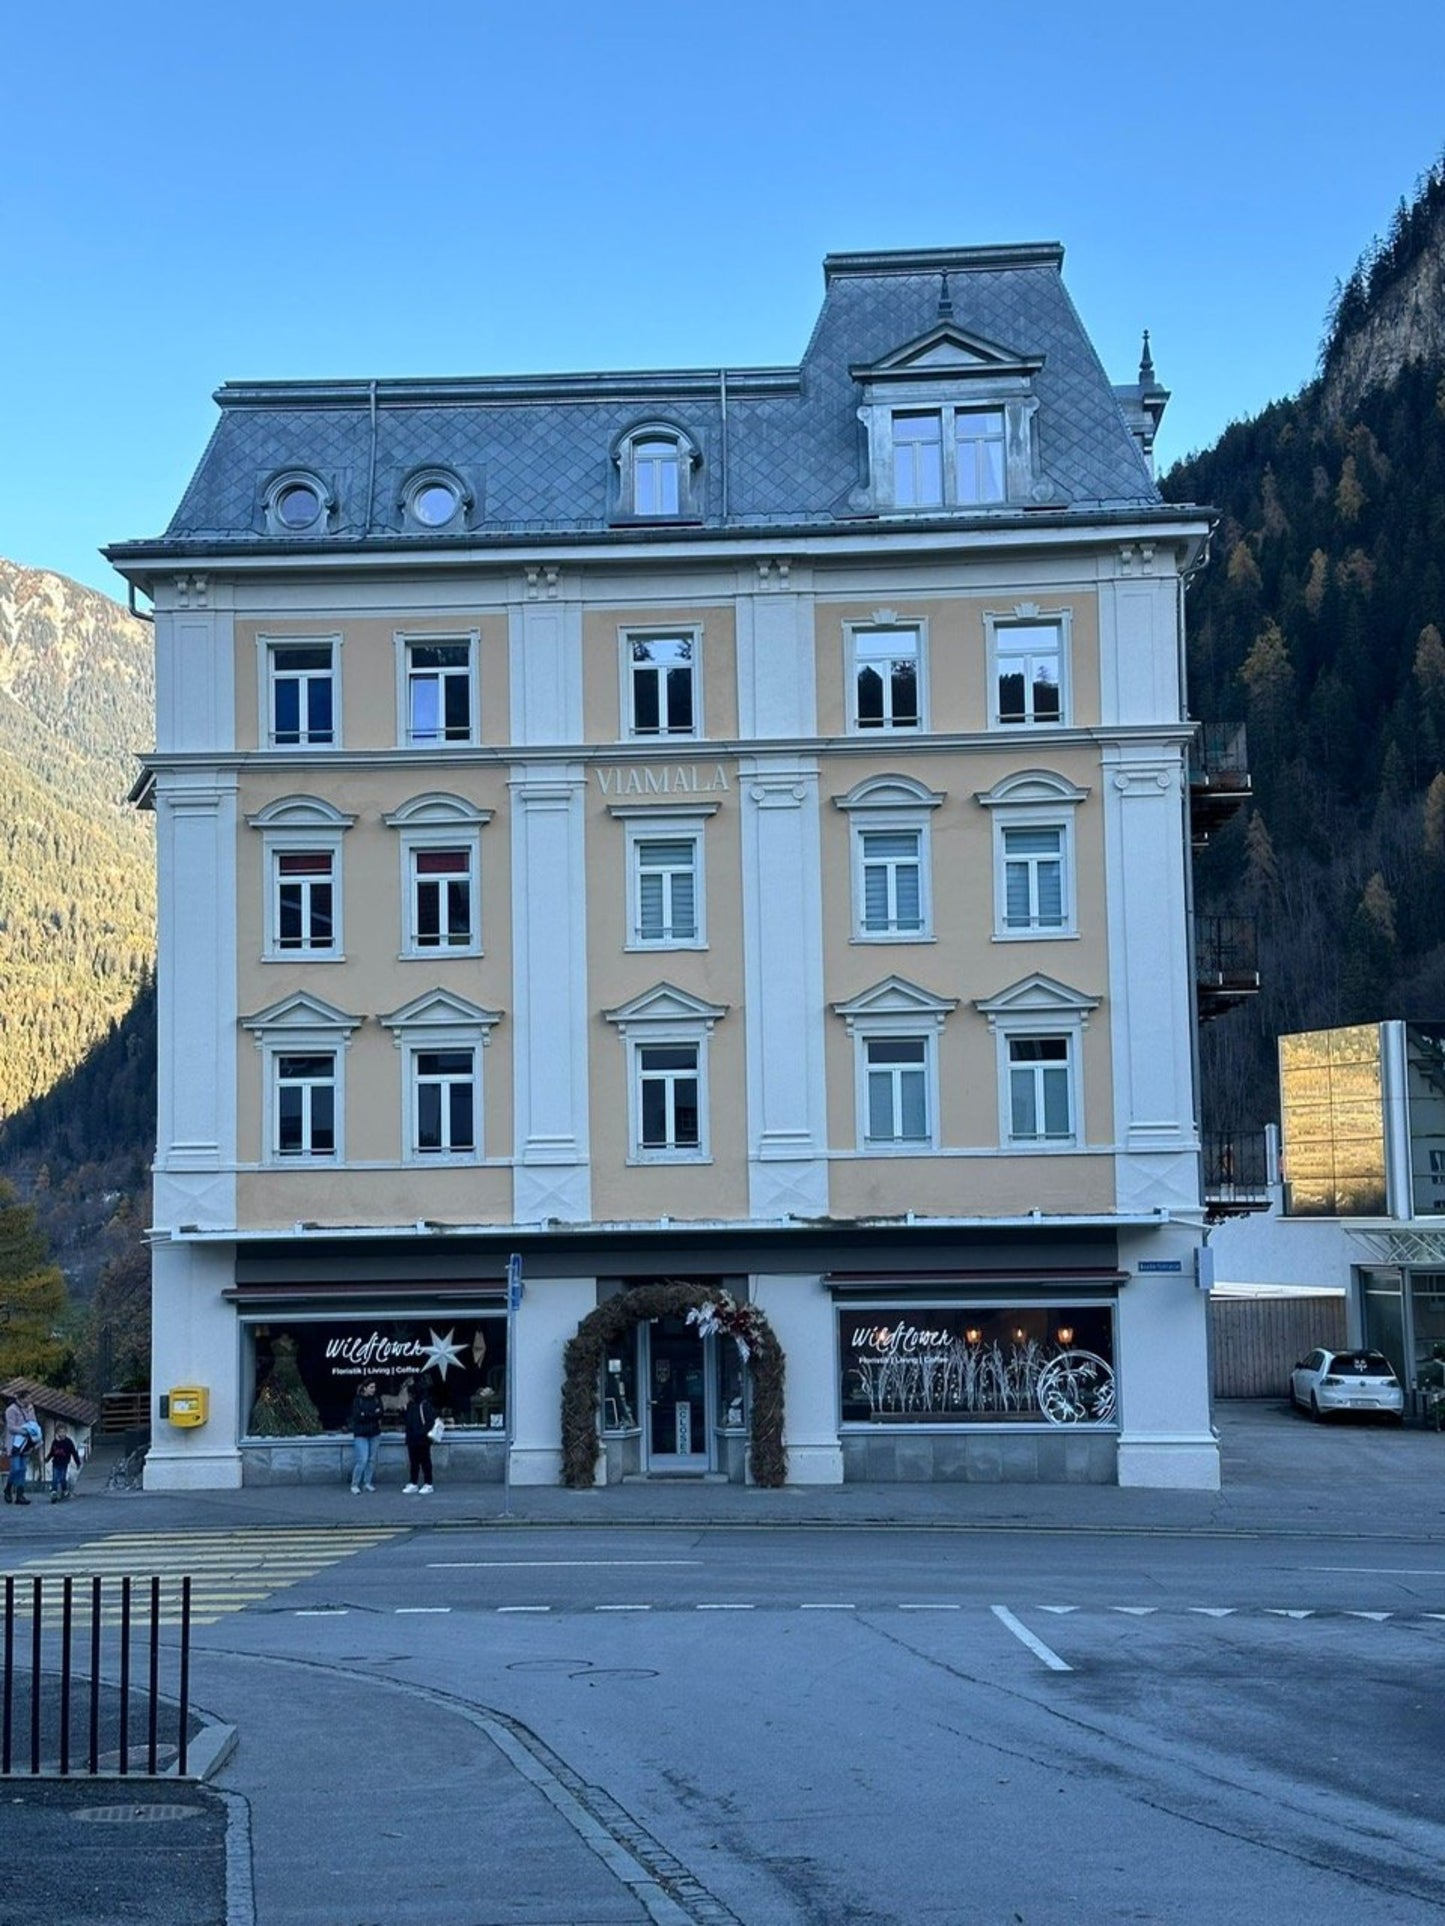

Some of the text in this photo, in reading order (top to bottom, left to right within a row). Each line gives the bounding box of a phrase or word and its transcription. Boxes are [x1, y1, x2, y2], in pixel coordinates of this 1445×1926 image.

[595, 764, 730, 795] VIAMALA
[332, 1365, 420, 1375] Floristik Living Coffee
